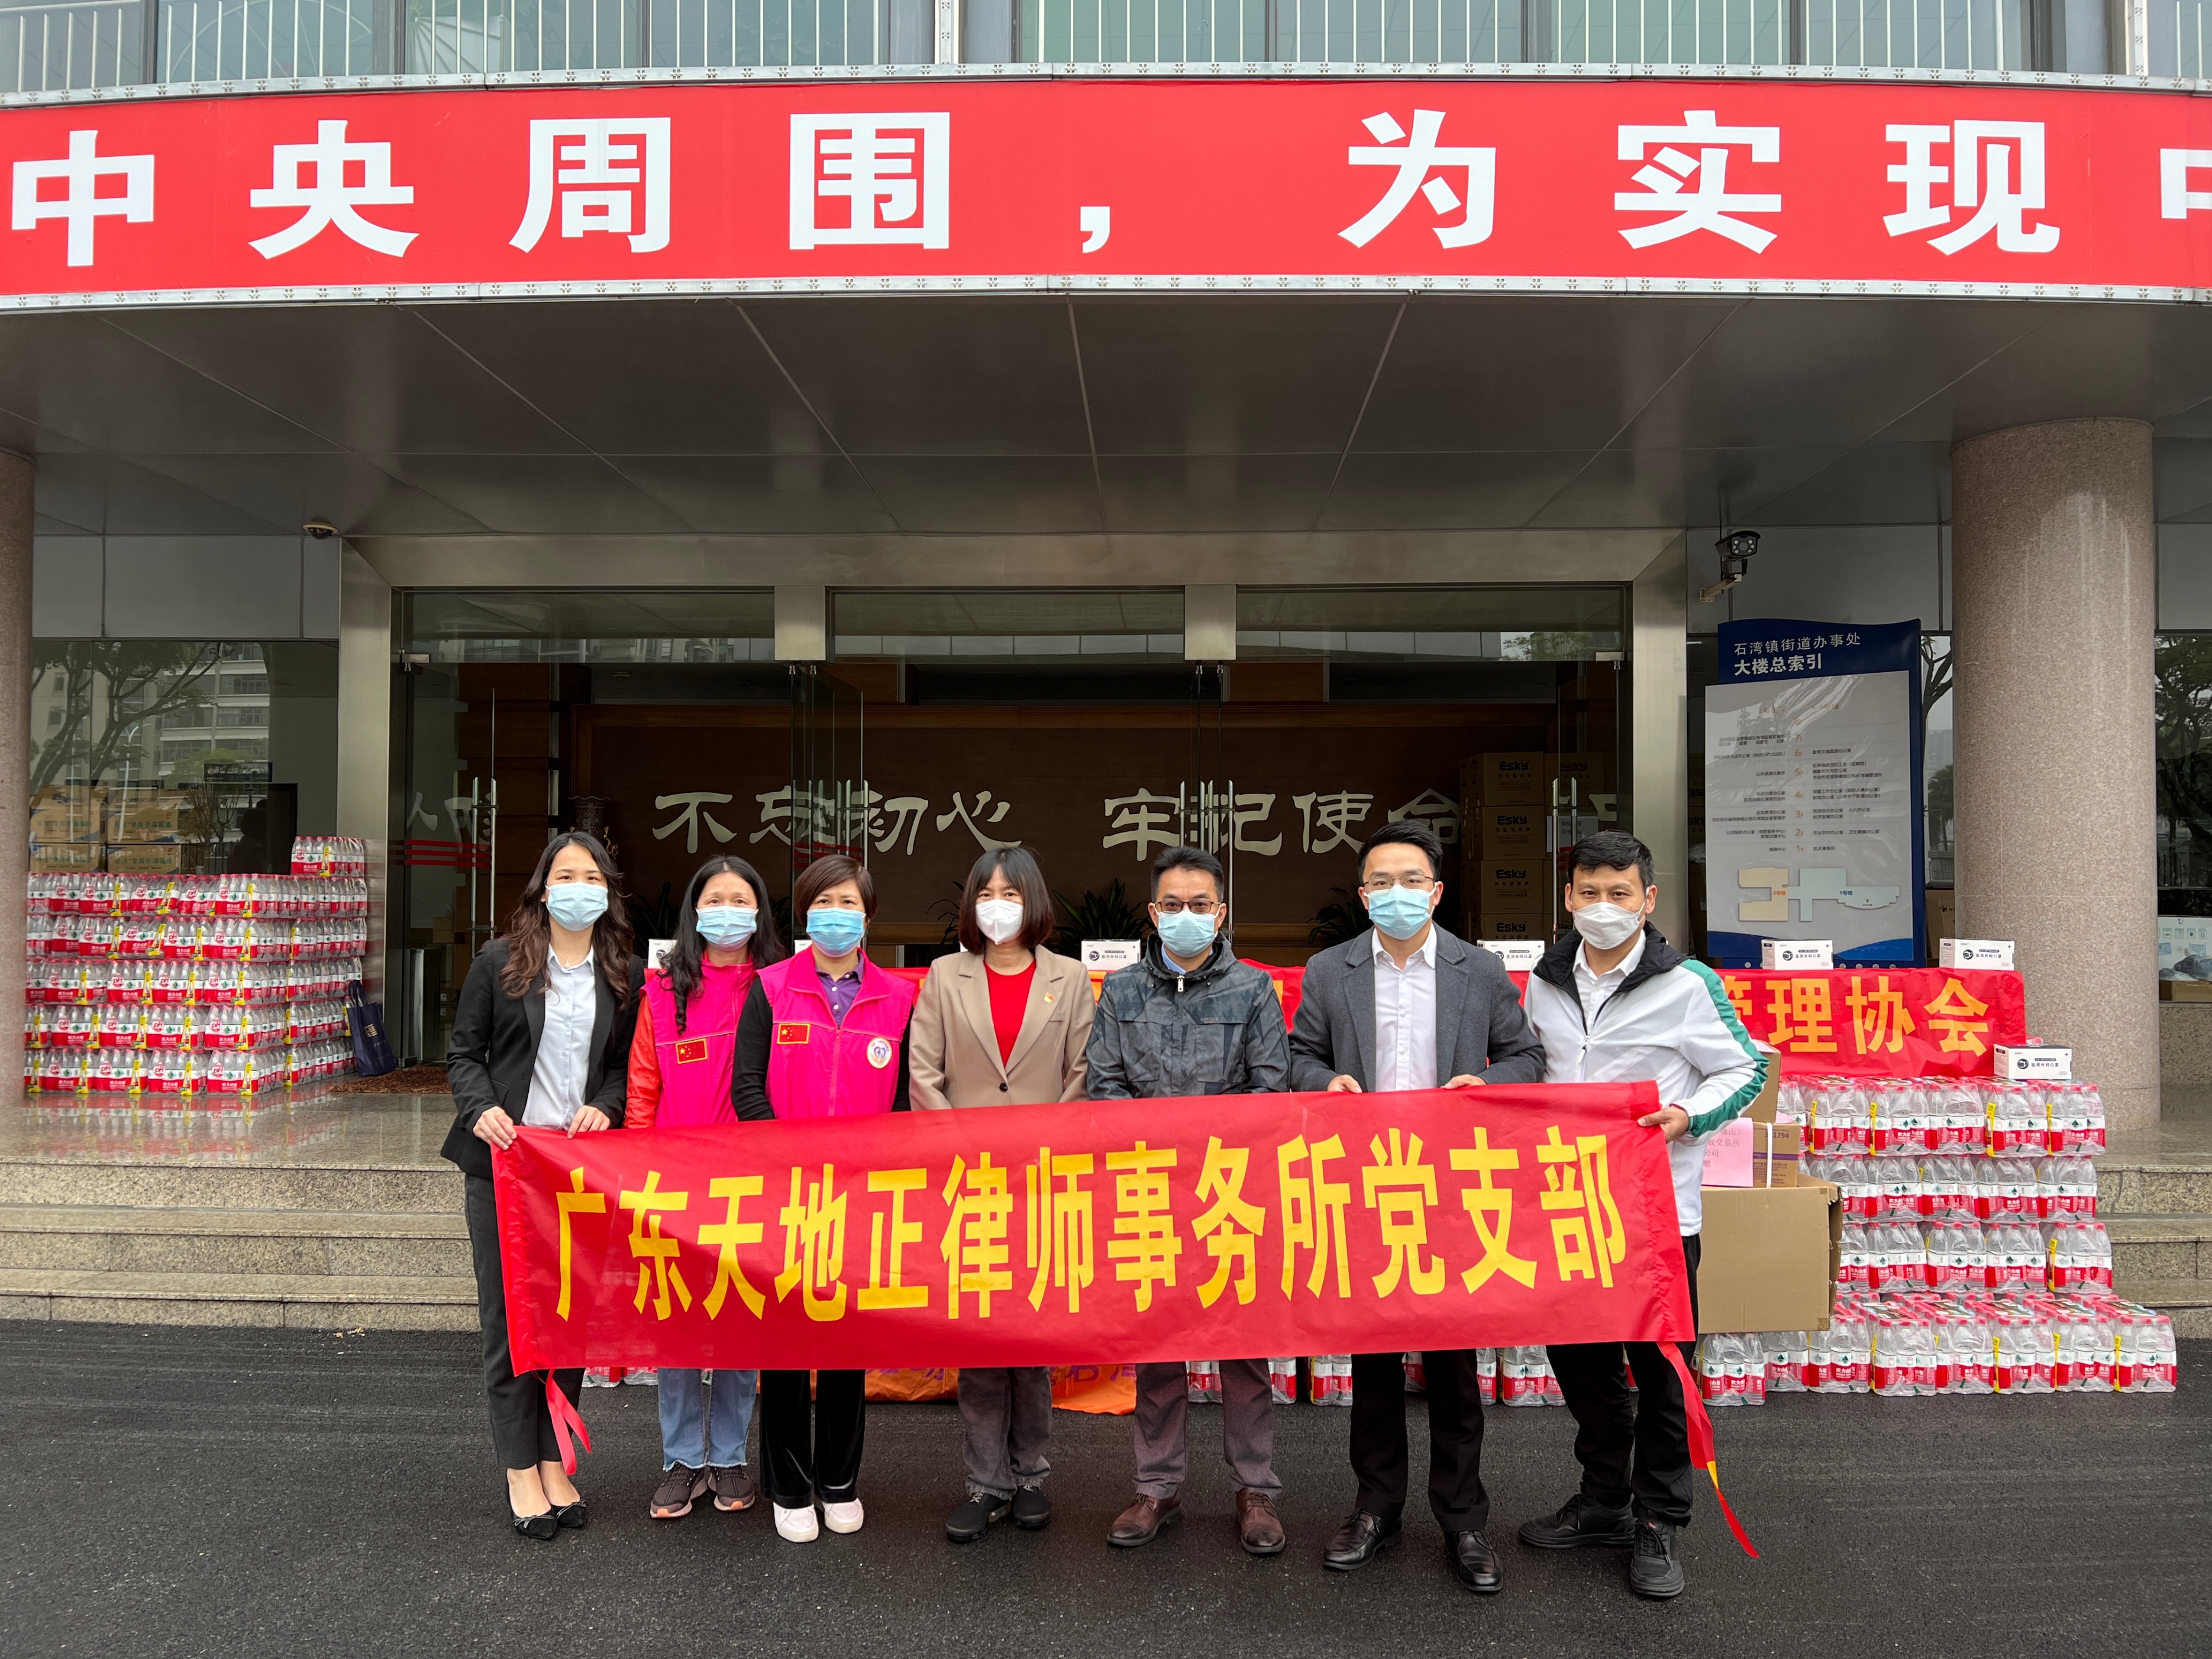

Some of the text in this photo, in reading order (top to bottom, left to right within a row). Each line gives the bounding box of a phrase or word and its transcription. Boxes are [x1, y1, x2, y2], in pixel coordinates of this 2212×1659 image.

[1734, 632, 1861, 656] 石湾镇街道办事处
[1734, 653, 1822, 676] 大楼总索引
[1499, 761, 1529, 771] Esky
[1497, 815, 1528, 825] Esky
[1496, 869, 1526, 879] Esky
[1496, 922, 1526, 932] Esky
[556, 1125, 1627, 1322] 广东天地正律师事务所党支部
